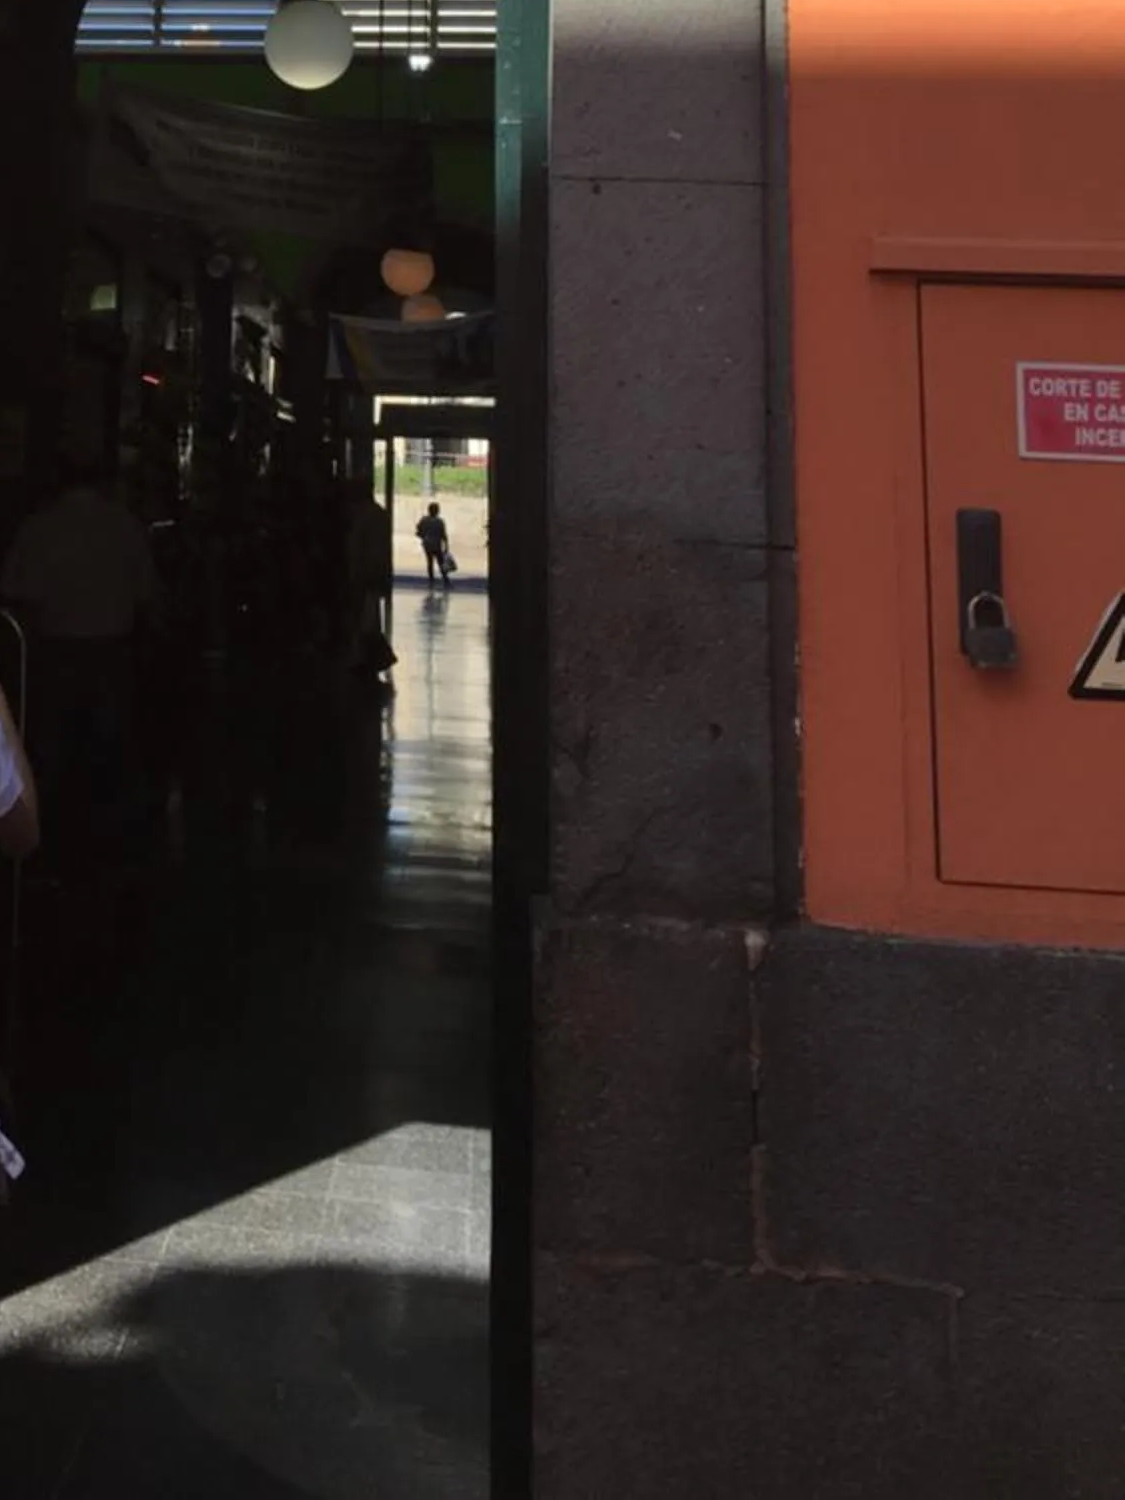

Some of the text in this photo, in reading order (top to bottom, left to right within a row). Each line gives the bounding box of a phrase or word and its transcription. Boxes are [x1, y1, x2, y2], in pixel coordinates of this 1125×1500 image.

[1029, 376, 1122, 398] CORTE DE
[1064, 402, 1089, 422] EN
